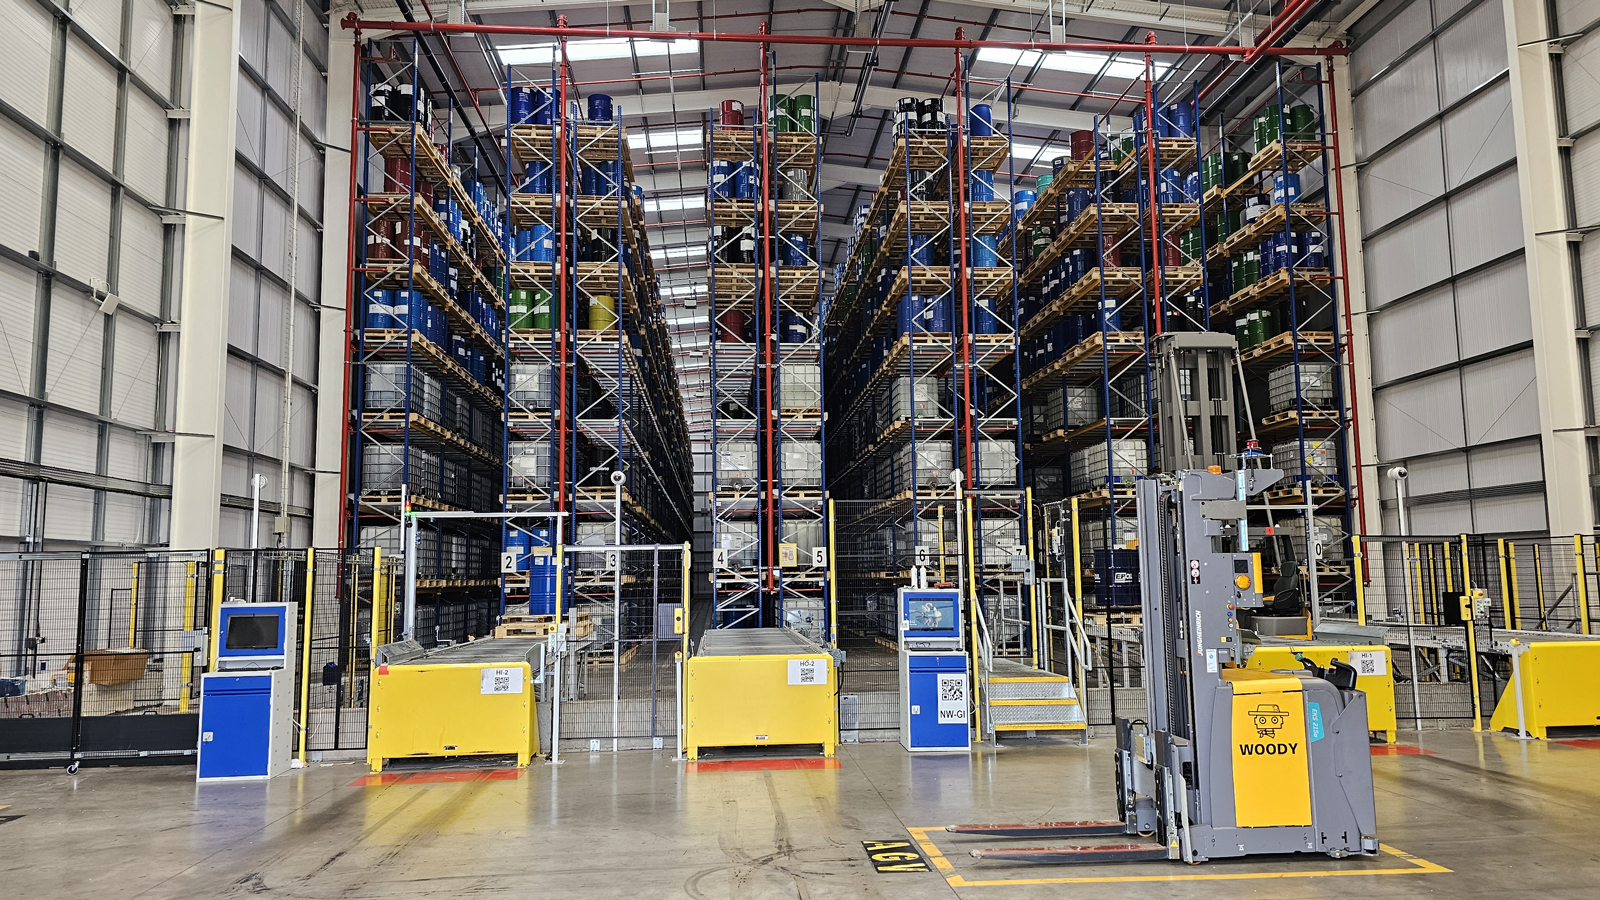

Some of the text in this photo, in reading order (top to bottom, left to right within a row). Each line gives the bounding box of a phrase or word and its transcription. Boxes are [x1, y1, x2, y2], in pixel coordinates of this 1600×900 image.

[919, 549, 926, 562] 6
[1016, 548, 1022, 556] 7
[1315, 543, 1321, 556] 0
[505, 555, 512, 569] 2
[610, 554, 616, 568] 3
[717, 551, 724, 564] 4
[816, 550, 823, 564] 5
[1195, 609, 1203, 657] JUNGHEINRICH
[940, 709, 966, 719] NW-GI
[1311, 708, 1319, 722] EKS
[1239, 743, 1299, 756] WOODY
[863, 840, 930, 873] AGV
